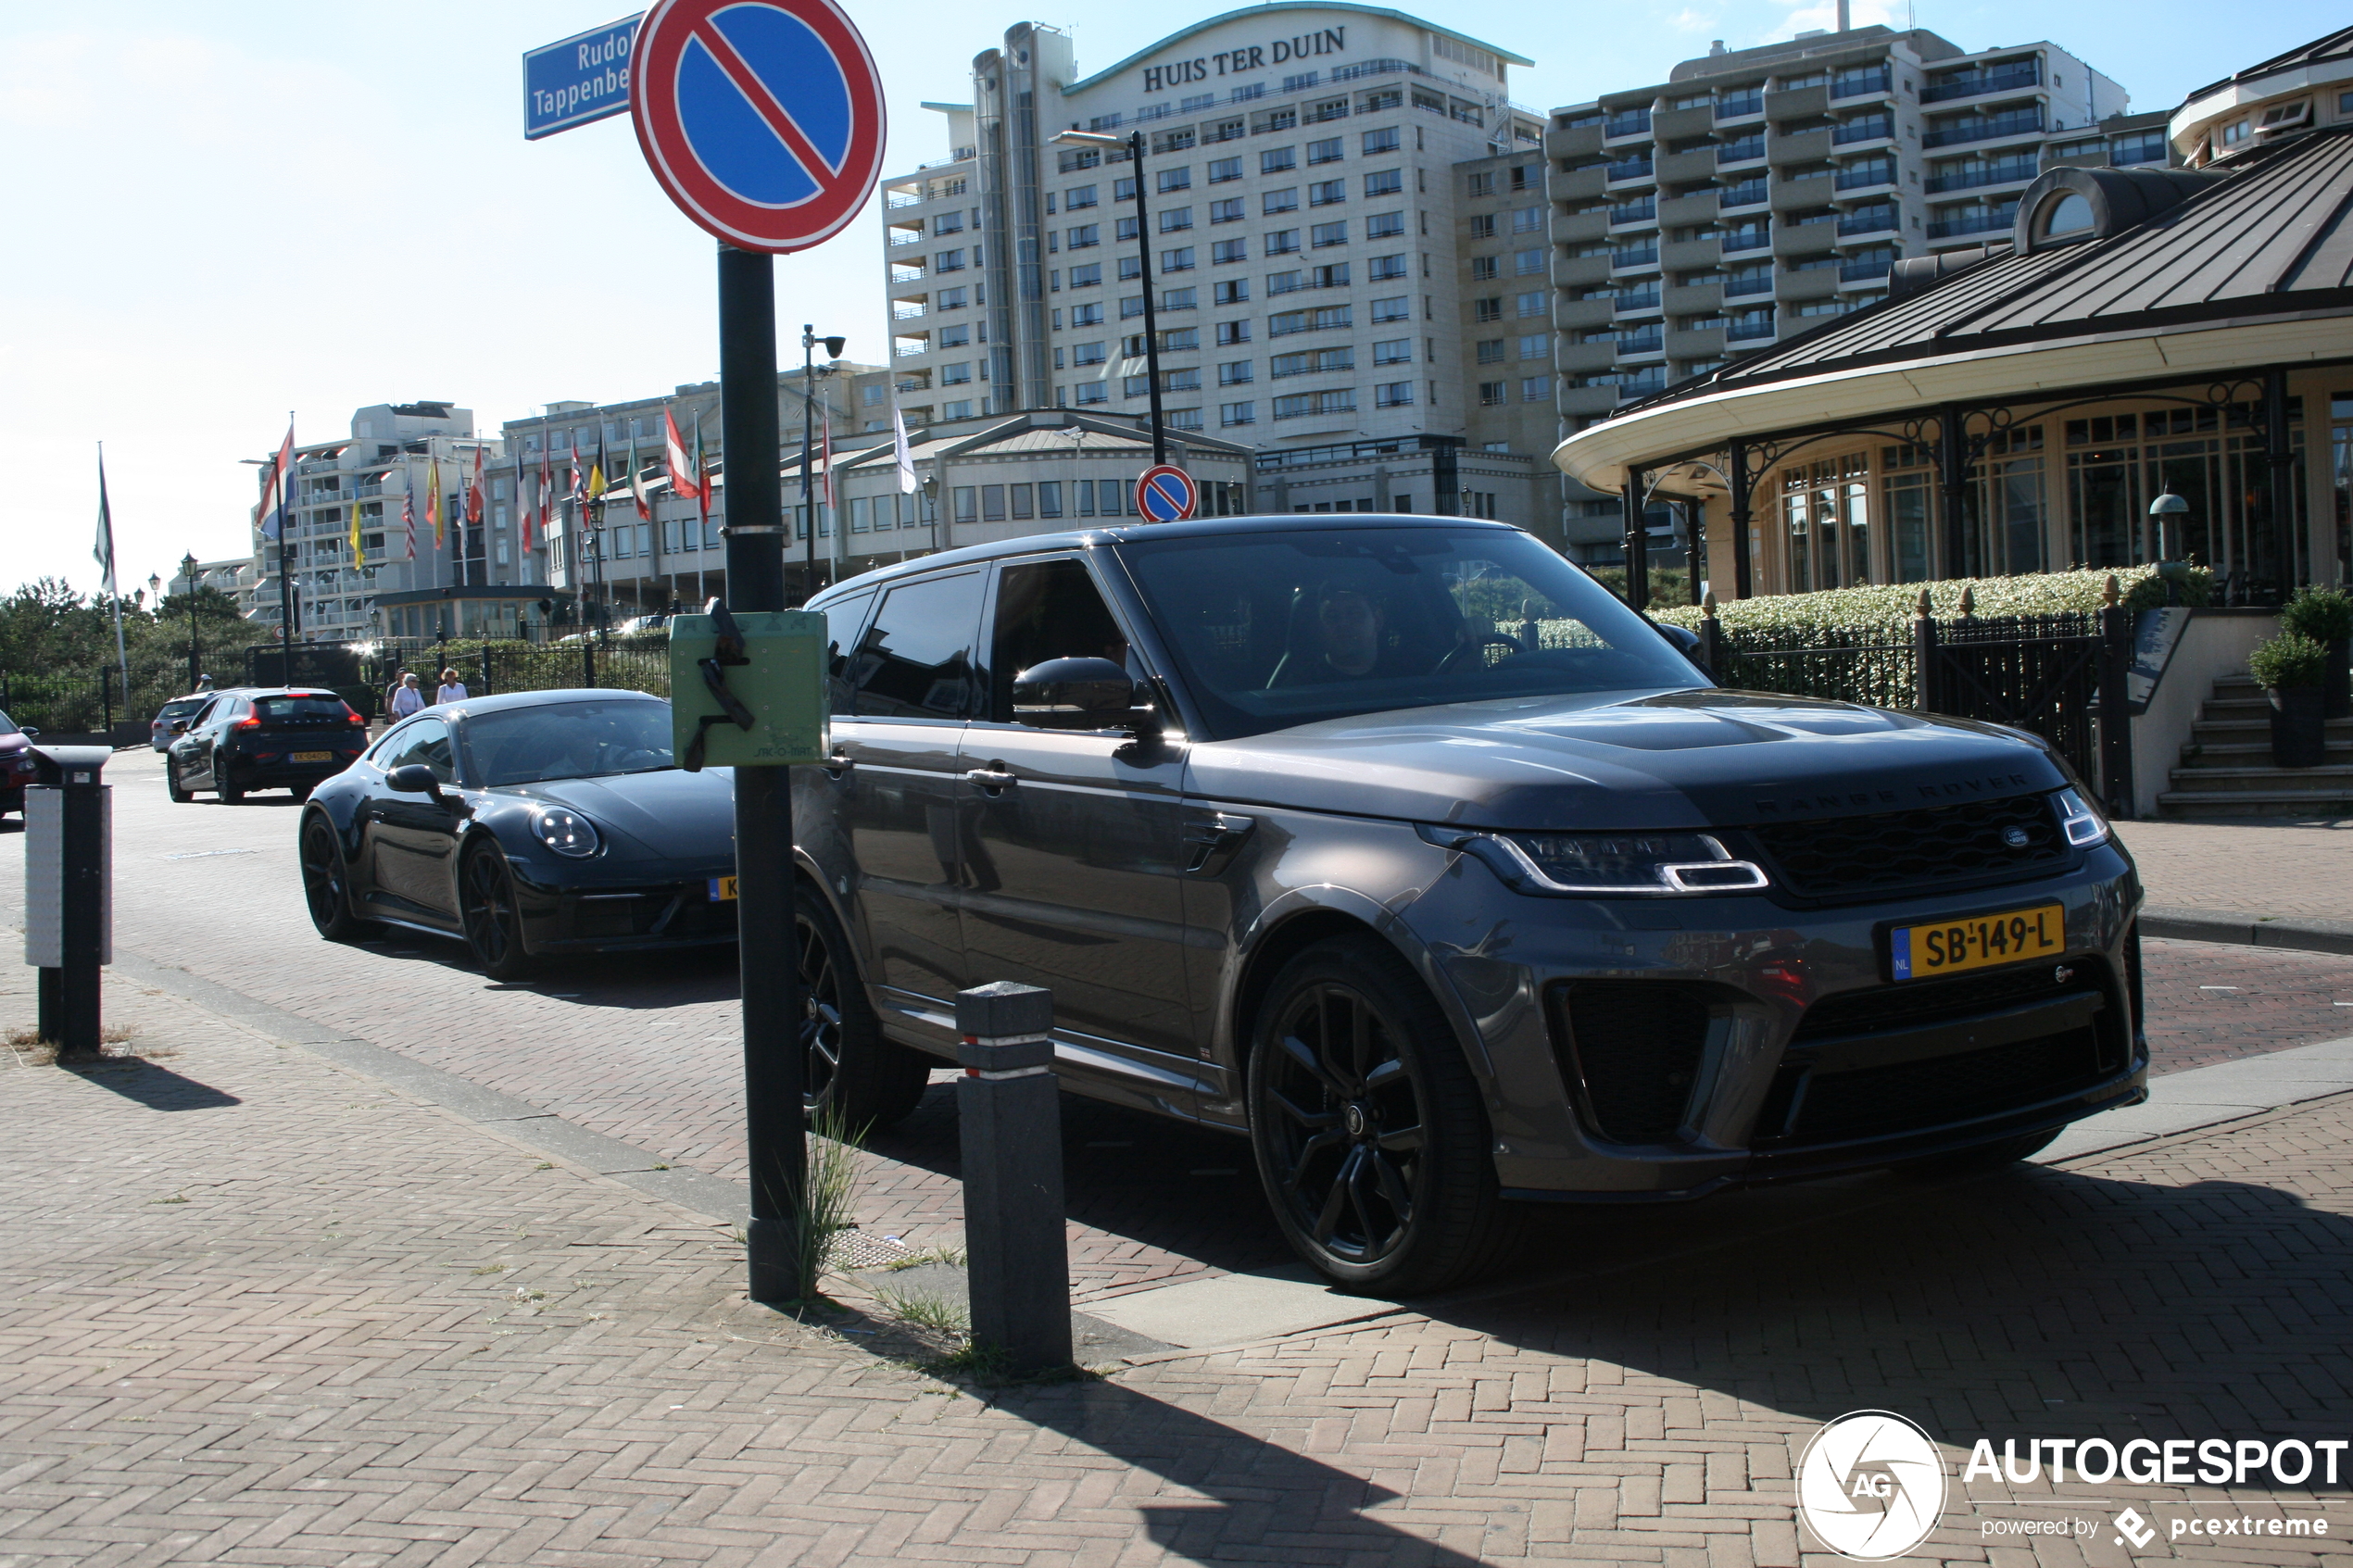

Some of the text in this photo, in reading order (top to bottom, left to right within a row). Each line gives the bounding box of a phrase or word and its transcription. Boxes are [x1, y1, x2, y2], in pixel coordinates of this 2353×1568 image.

[1143, 26, 1345, 93] HUIS TER DUIN
[1755, 773, 2027, 813] RANGE ROVER
[1895, 959, 1909, 972] NL
